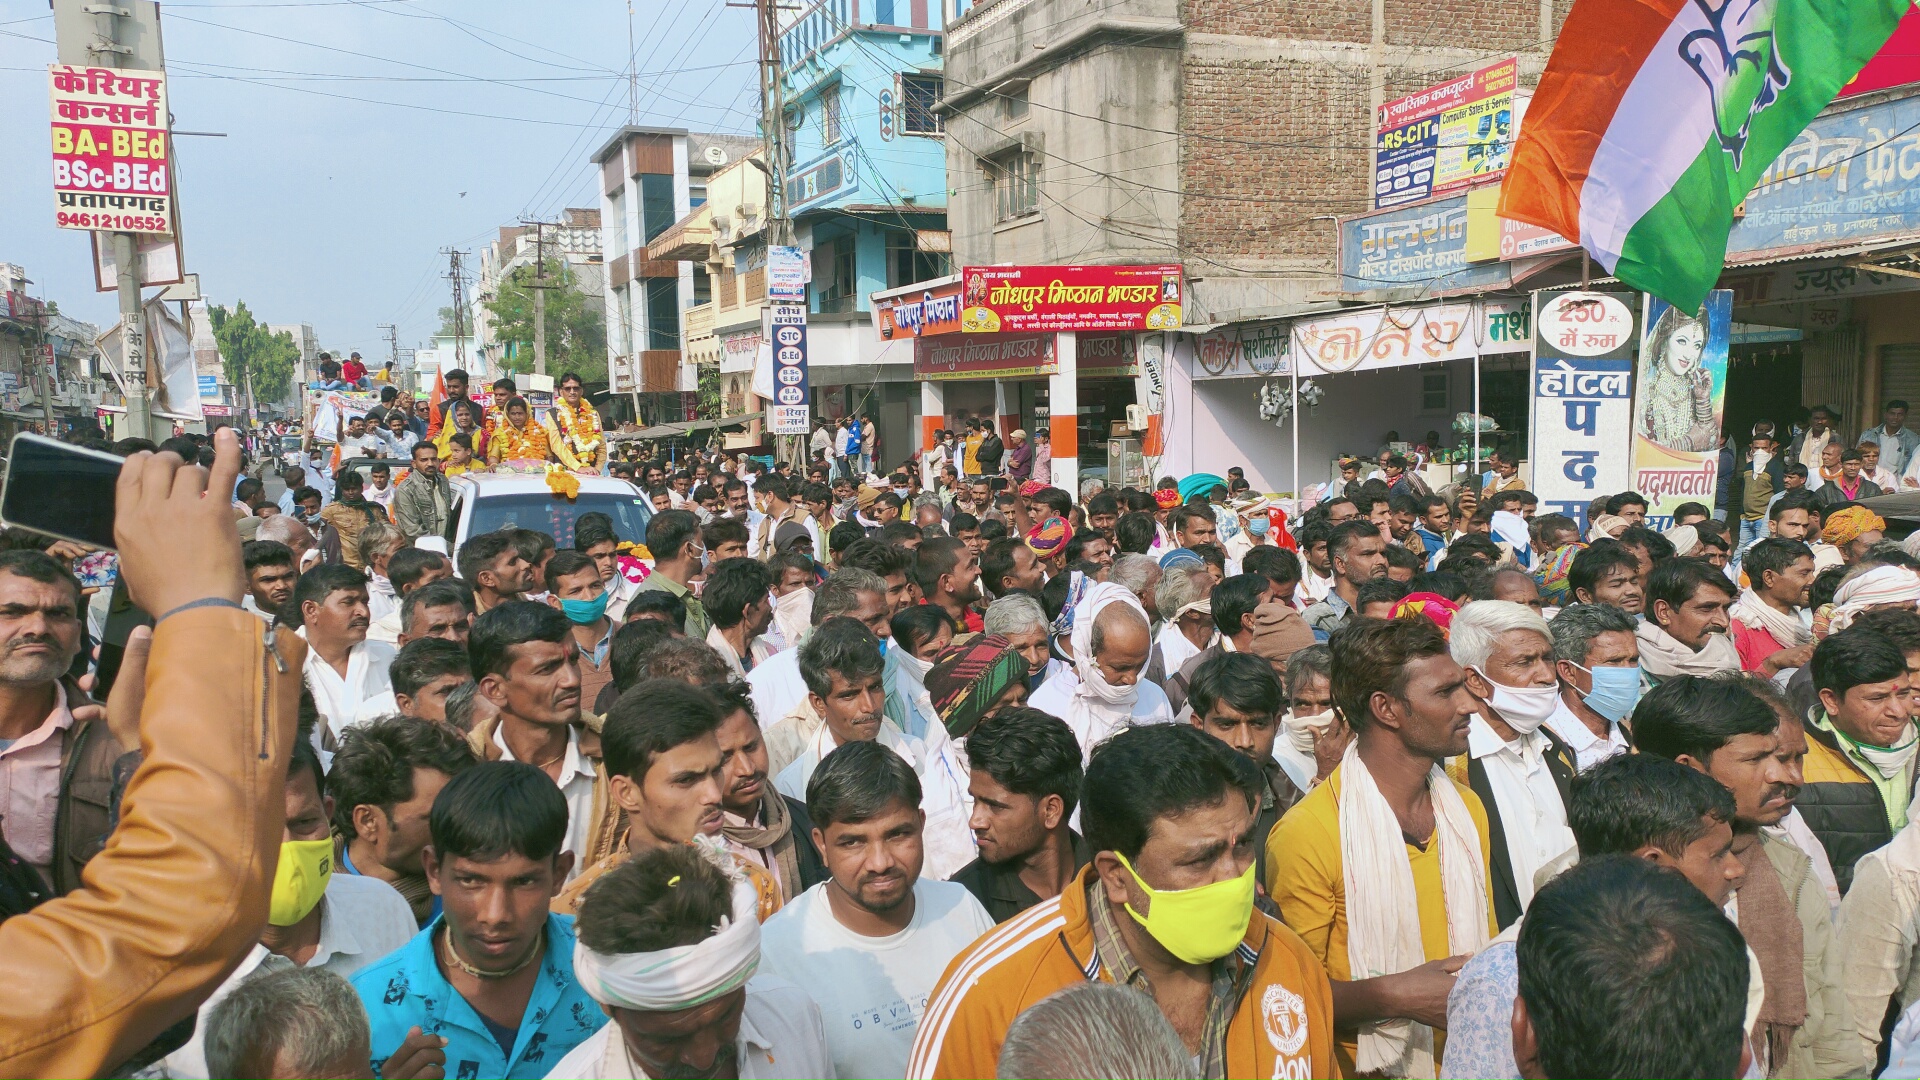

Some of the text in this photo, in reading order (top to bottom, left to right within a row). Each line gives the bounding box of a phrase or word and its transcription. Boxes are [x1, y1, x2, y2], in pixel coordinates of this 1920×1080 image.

[52, 66, 162, 99] केरियर
[56, 98, 160, 126] कन्सर्न
[1443, 109, 1467, 124] Computer
[1469, 104, 1484, 117] Sales
[1385, 120, 1432, 151] RS-CIT
[54, 160, 166, 192] BSc-BEd
[58, 192, 165, 215] प्रतापगढ़
[57, 212, 167, 231] 9461210552
[990, 279, 1159, 312] जोधपुर मिष्ठान भण्डार
[780, 332, 799, 341] STC
[1083, 337, 1118, 358] भण्डार
[1559, 328, 1578, 348] में
[781, 351, 800, 360] B.Ed
[931, 342, 962, 371] जोधपुर
[1002, 338, 1039, 360] भण्डार
[1538, 360, 1631, 396] होटल
[1263, 989, 1300, 1013] MANCHESTER
[1276, 1036, 1302, 1051] UNITED
